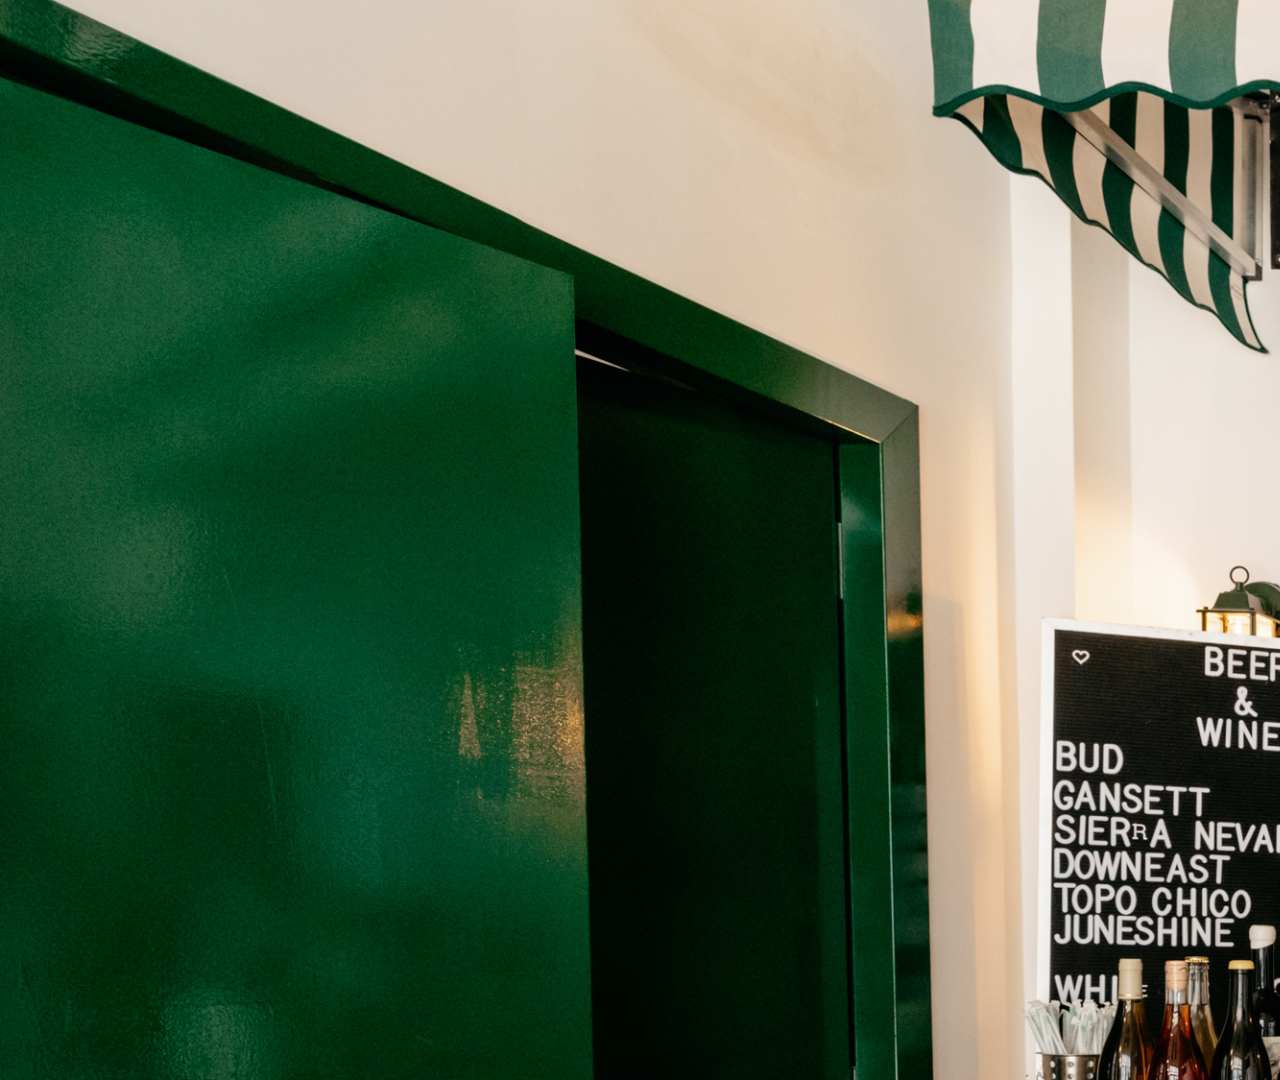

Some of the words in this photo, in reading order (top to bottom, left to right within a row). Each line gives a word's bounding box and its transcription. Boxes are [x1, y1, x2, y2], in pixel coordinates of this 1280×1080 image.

[1233, 687, 1258, 717] &
[1055, 741, 1124, 775] BUD
[1054, 780, 1211, 817] GANSETT
[1054, 847, 1231, 886] DOWNEAST
[1053, 881, 1138, 916] TOPO
[1152, 886, 1252, 921] CHICO
[1054, 914, 1235, 949] JUNESHINE
[1054, 974, 1149, 1002] WHIE
